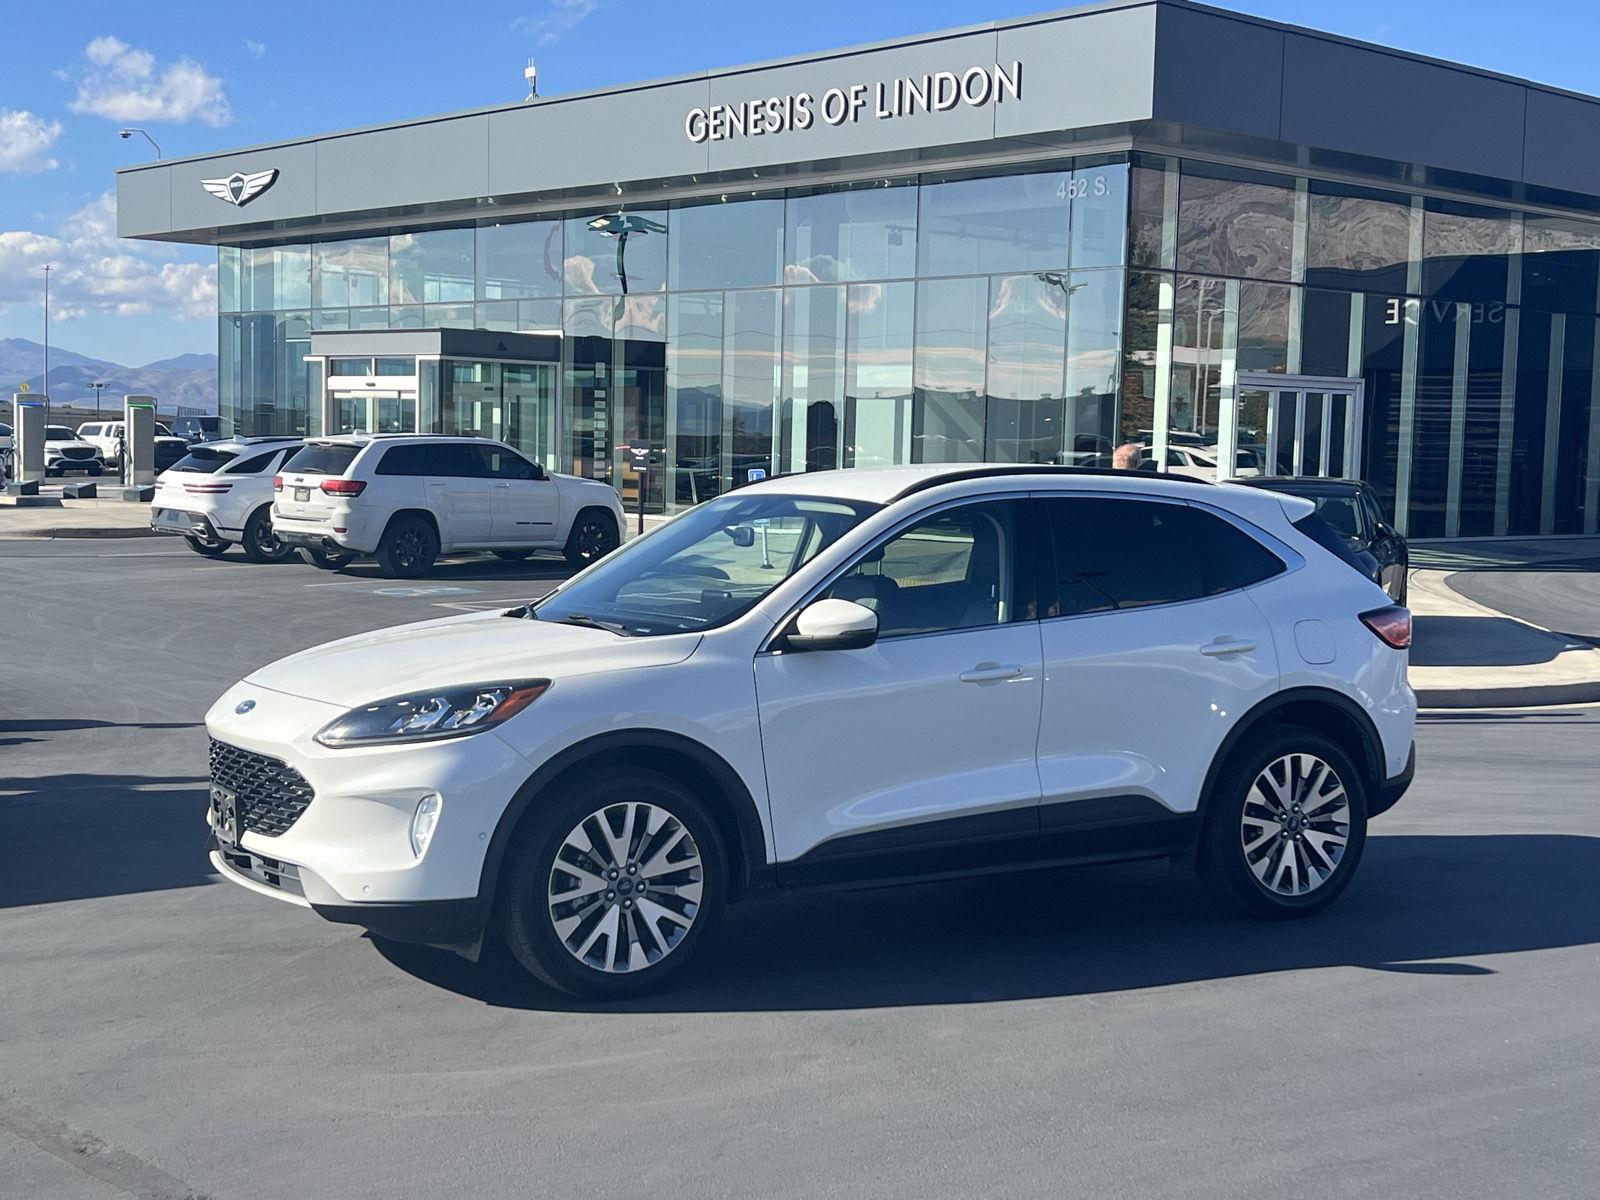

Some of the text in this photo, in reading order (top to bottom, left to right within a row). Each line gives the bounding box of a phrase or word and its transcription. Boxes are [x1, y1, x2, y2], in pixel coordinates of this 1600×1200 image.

[686, 61, 1022, 143] GENESIS OF LINDON
[1056, 175, 1111, 199] 452 S.
